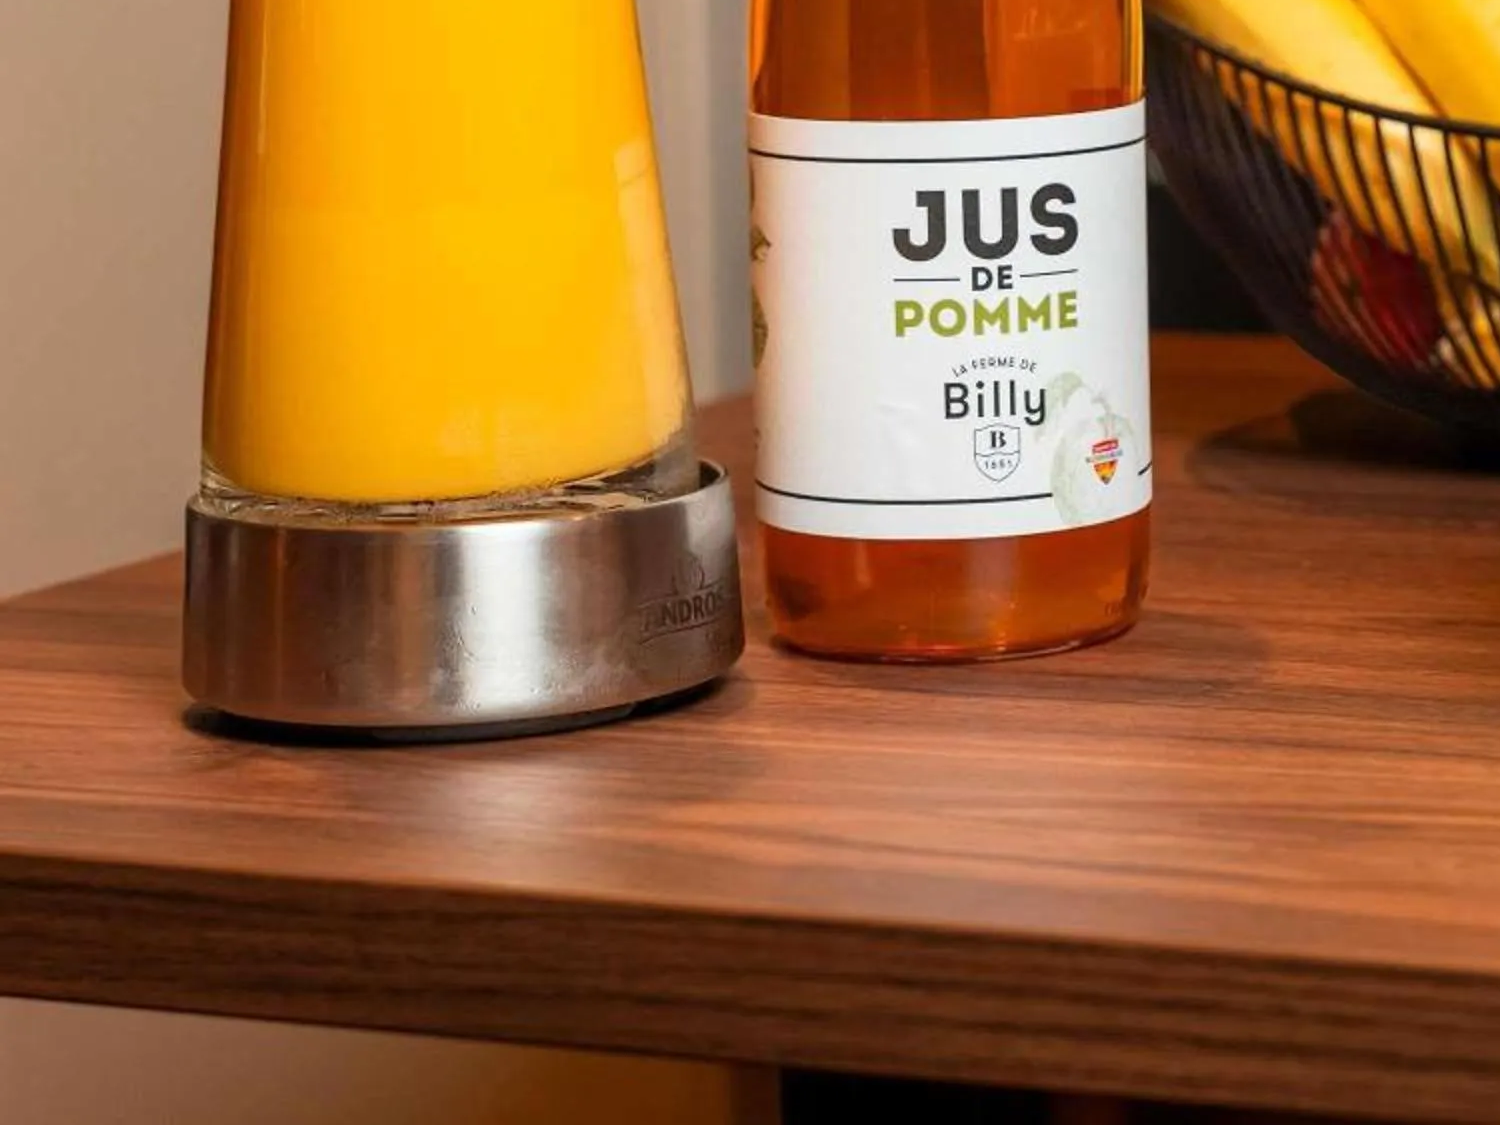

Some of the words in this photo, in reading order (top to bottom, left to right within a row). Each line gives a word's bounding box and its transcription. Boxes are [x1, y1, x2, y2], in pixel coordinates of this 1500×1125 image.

[892, 182, 1079, 262] JUS
[971, 264, 1014, 292] DE
[893, 290, 1079, 338] POMME
[951, 364, 968, 377] LA
[971, 356, 1015, 370] FERME
[1019, 358, 1038, 373] DE
[944, 380, 1046, 426] Billy
[990, 430, 1007, 448] B
